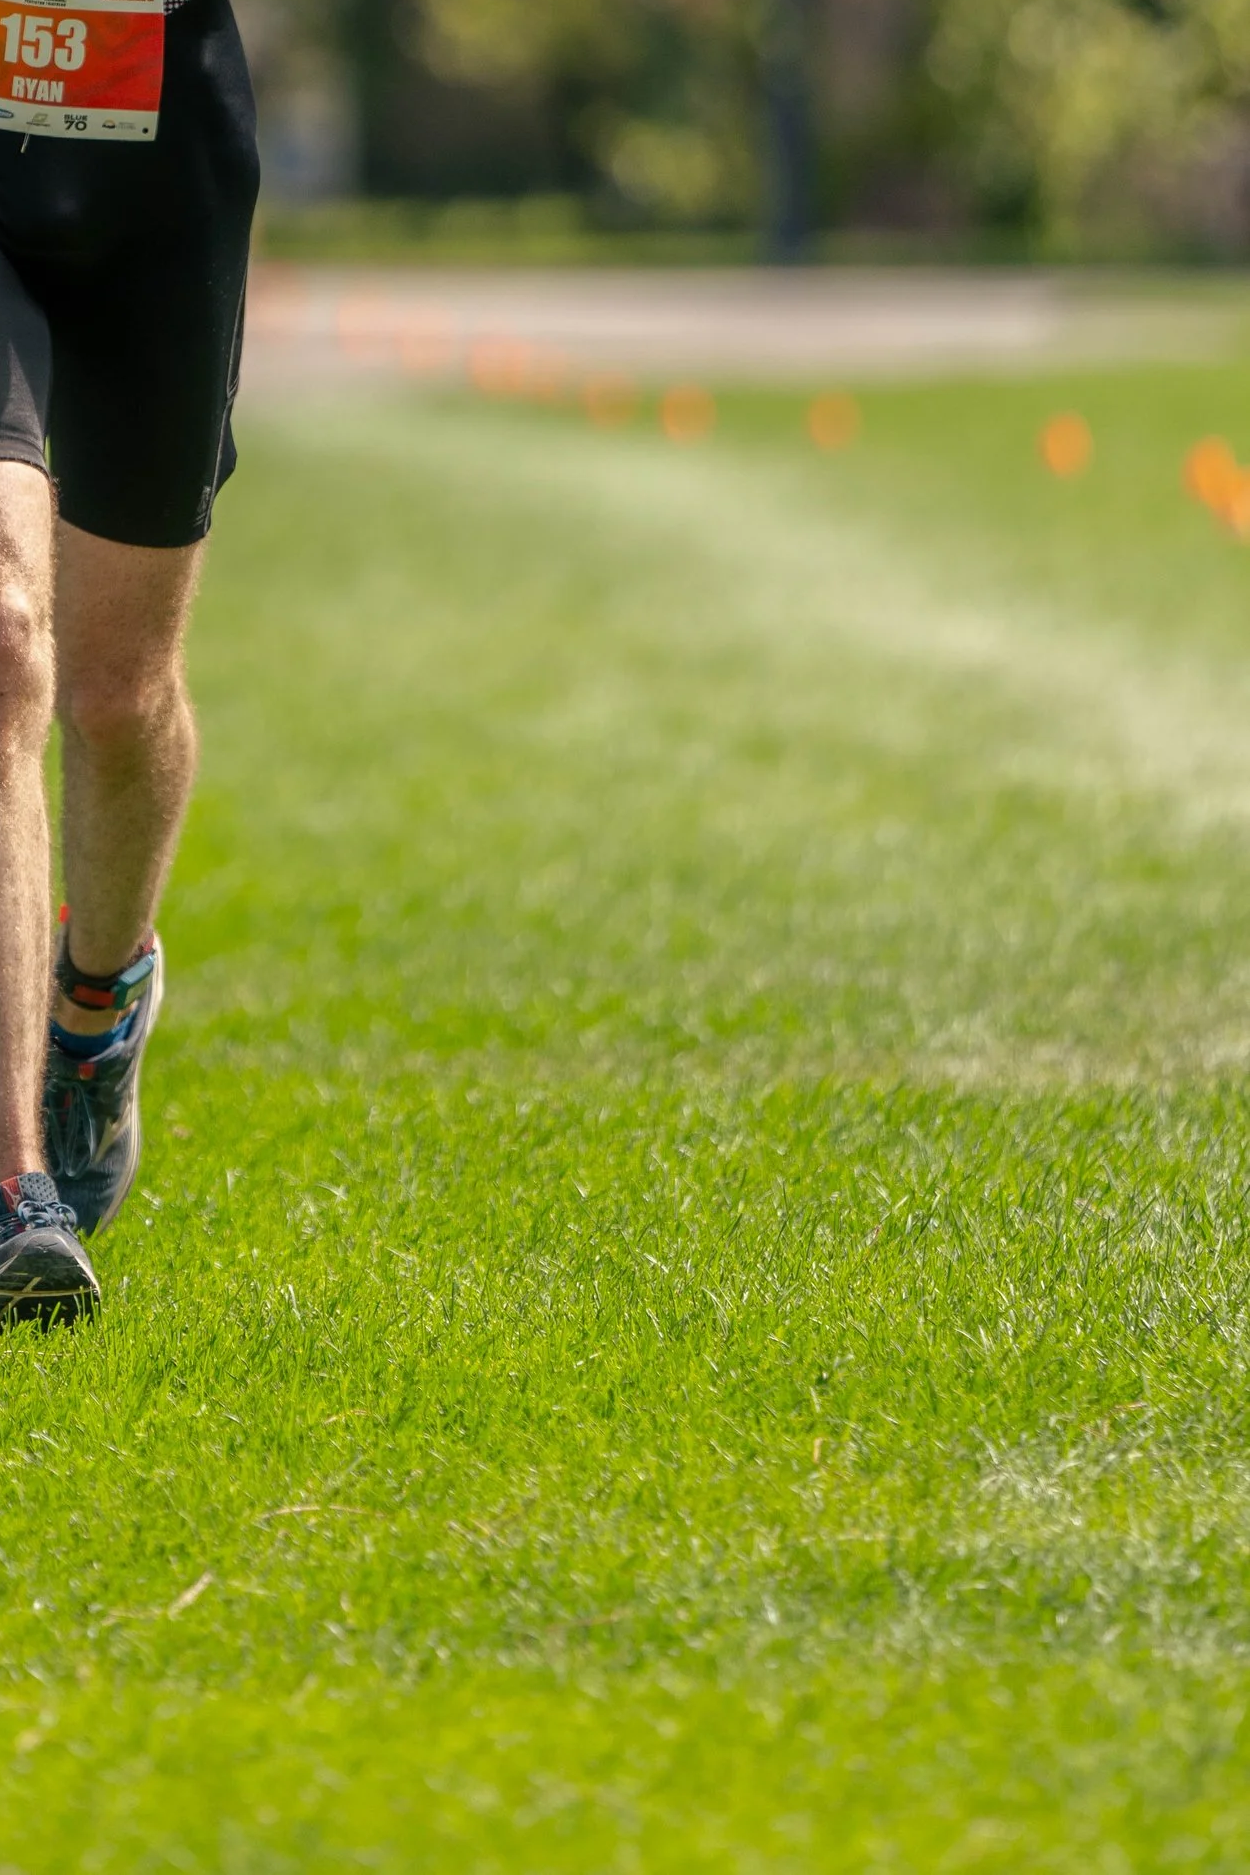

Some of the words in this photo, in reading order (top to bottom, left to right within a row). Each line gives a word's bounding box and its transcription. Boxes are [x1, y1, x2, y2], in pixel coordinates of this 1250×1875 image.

[0, 13, 87, 71] 153
[11, 75, 64, 103] RYAN
[64, 114, 88, 122] BLUE
[64, 121, 88, 131] 70
